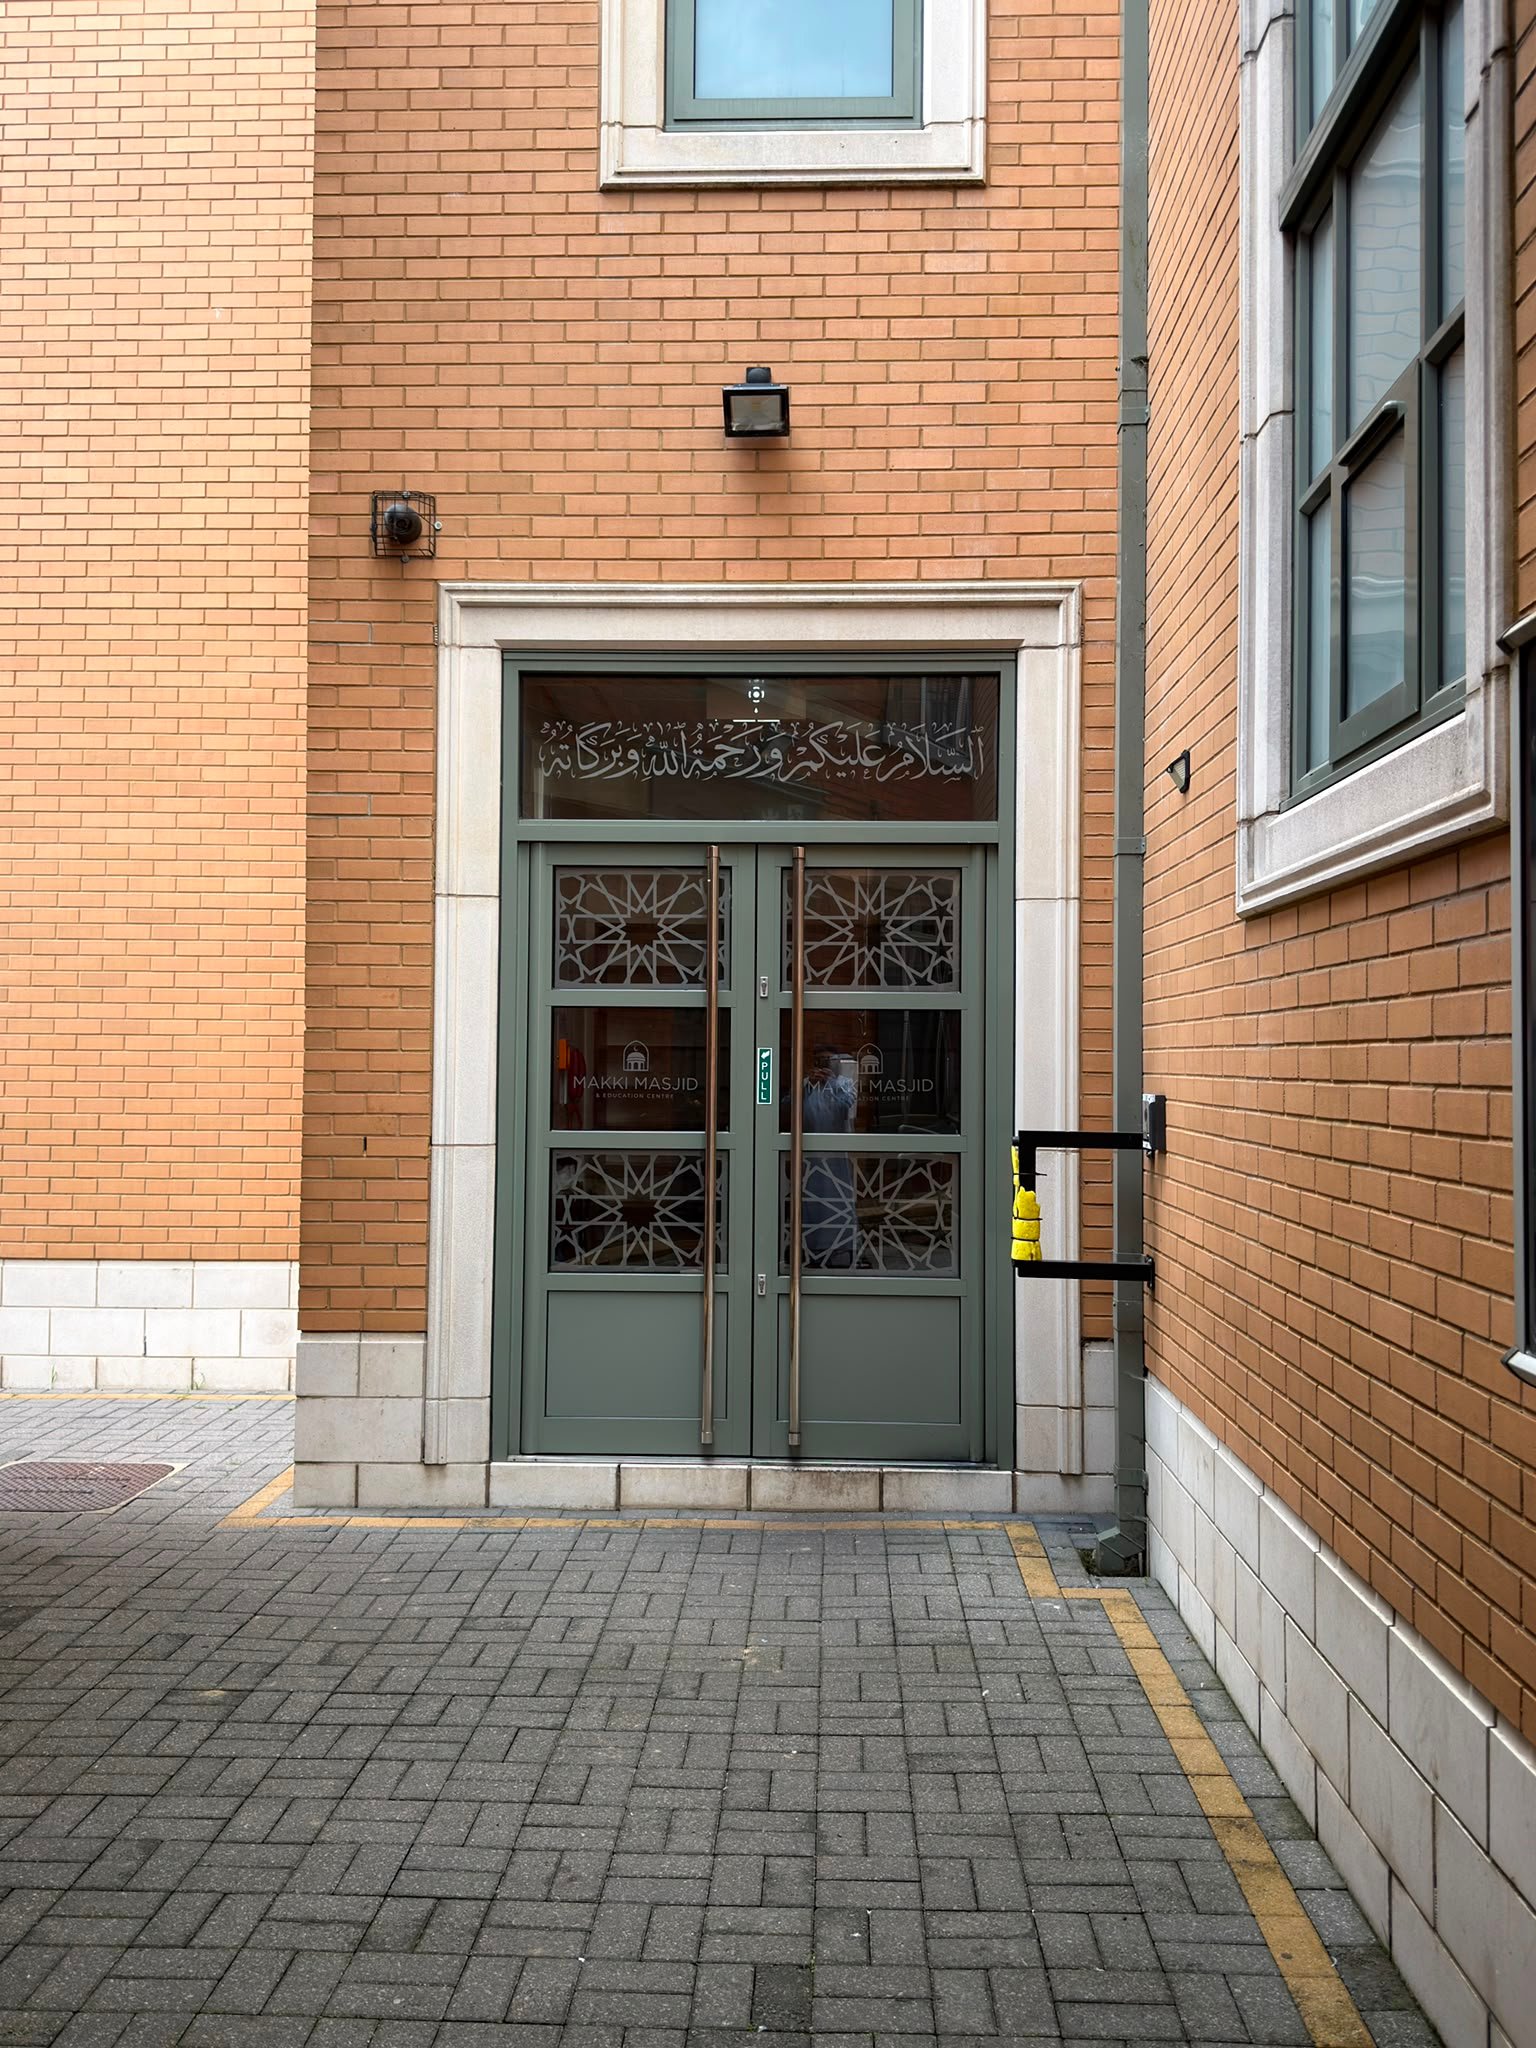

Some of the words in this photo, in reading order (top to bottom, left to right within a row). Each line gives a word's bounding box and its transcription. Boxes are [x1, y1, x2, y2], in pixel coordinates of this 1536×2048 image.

[573, 1076, 628, 1090] MAKKI
[635, 1077, 699, 1091] MASJID
[761, 1062, 769, 1100] PULL
[869, 1079, 934, 1093] MASJID
